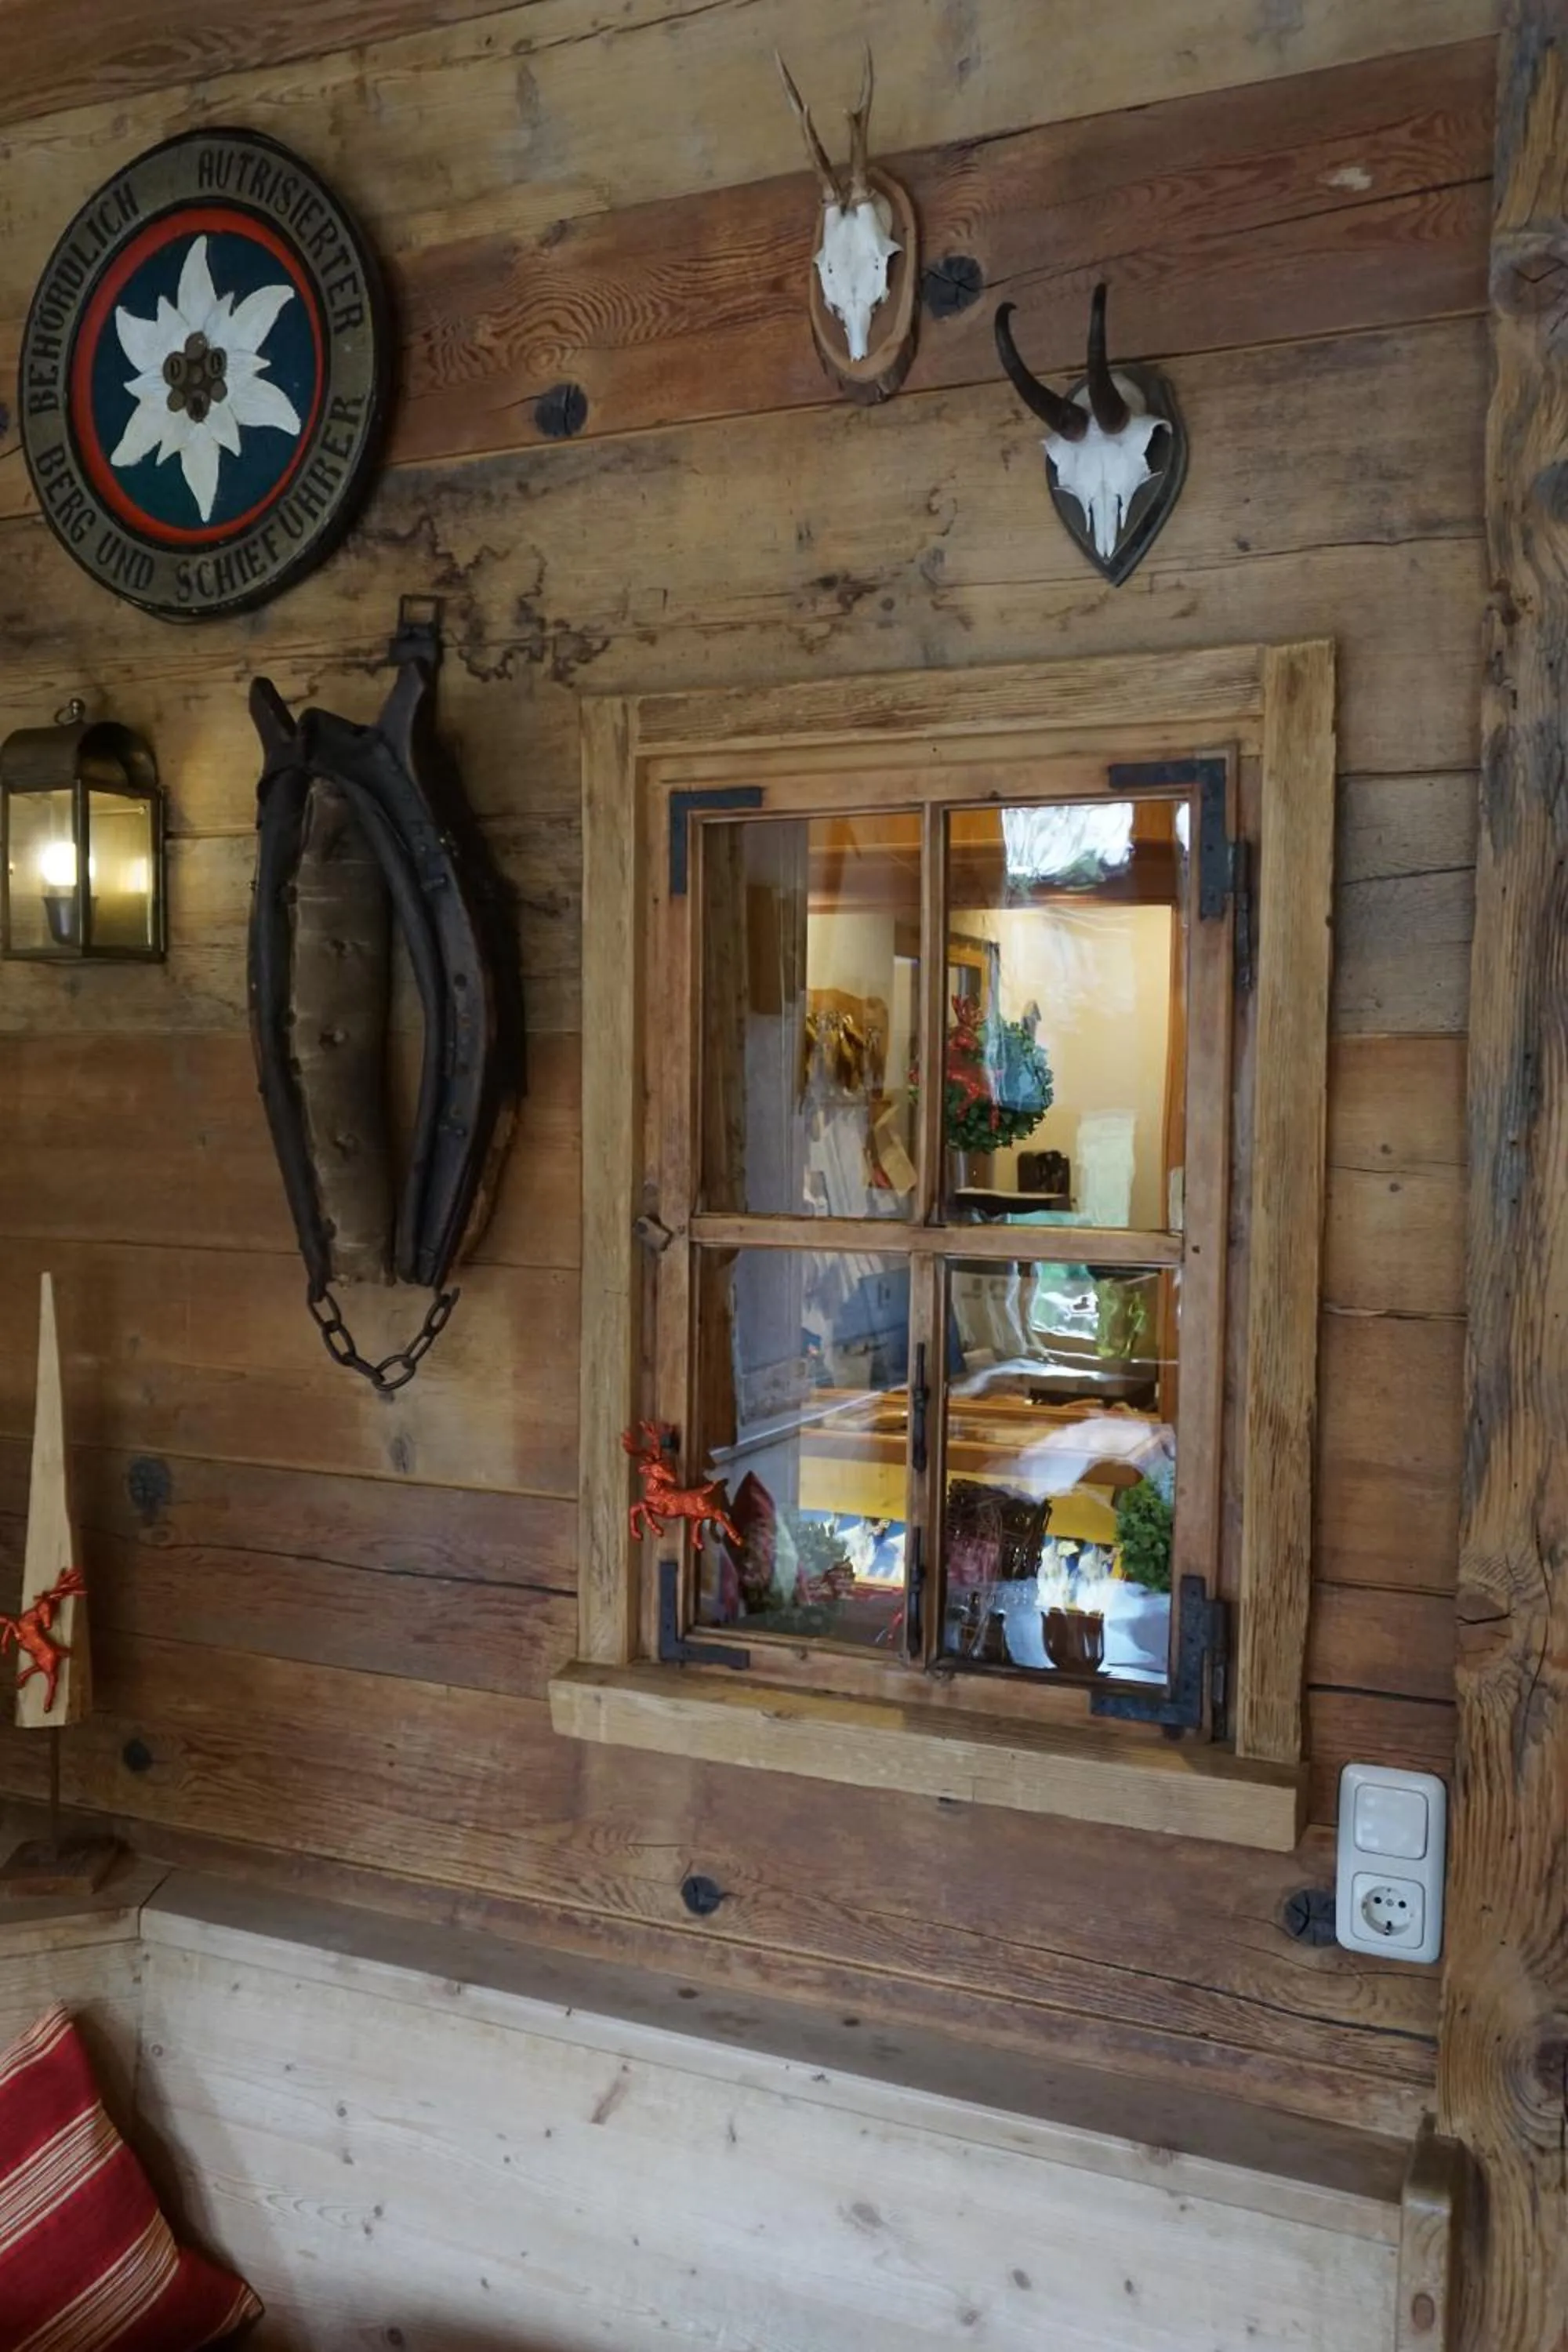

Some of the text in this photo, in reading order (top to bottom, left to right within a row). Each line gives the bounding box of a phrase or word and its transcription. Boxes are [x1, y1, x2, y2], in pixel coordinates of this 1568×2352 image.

[29, 148, 365, 415] BEHÖRDLICH AUTRISIERTER
[36, 445, 96, 542] BERG
[96, 529, 154, 591] UND
